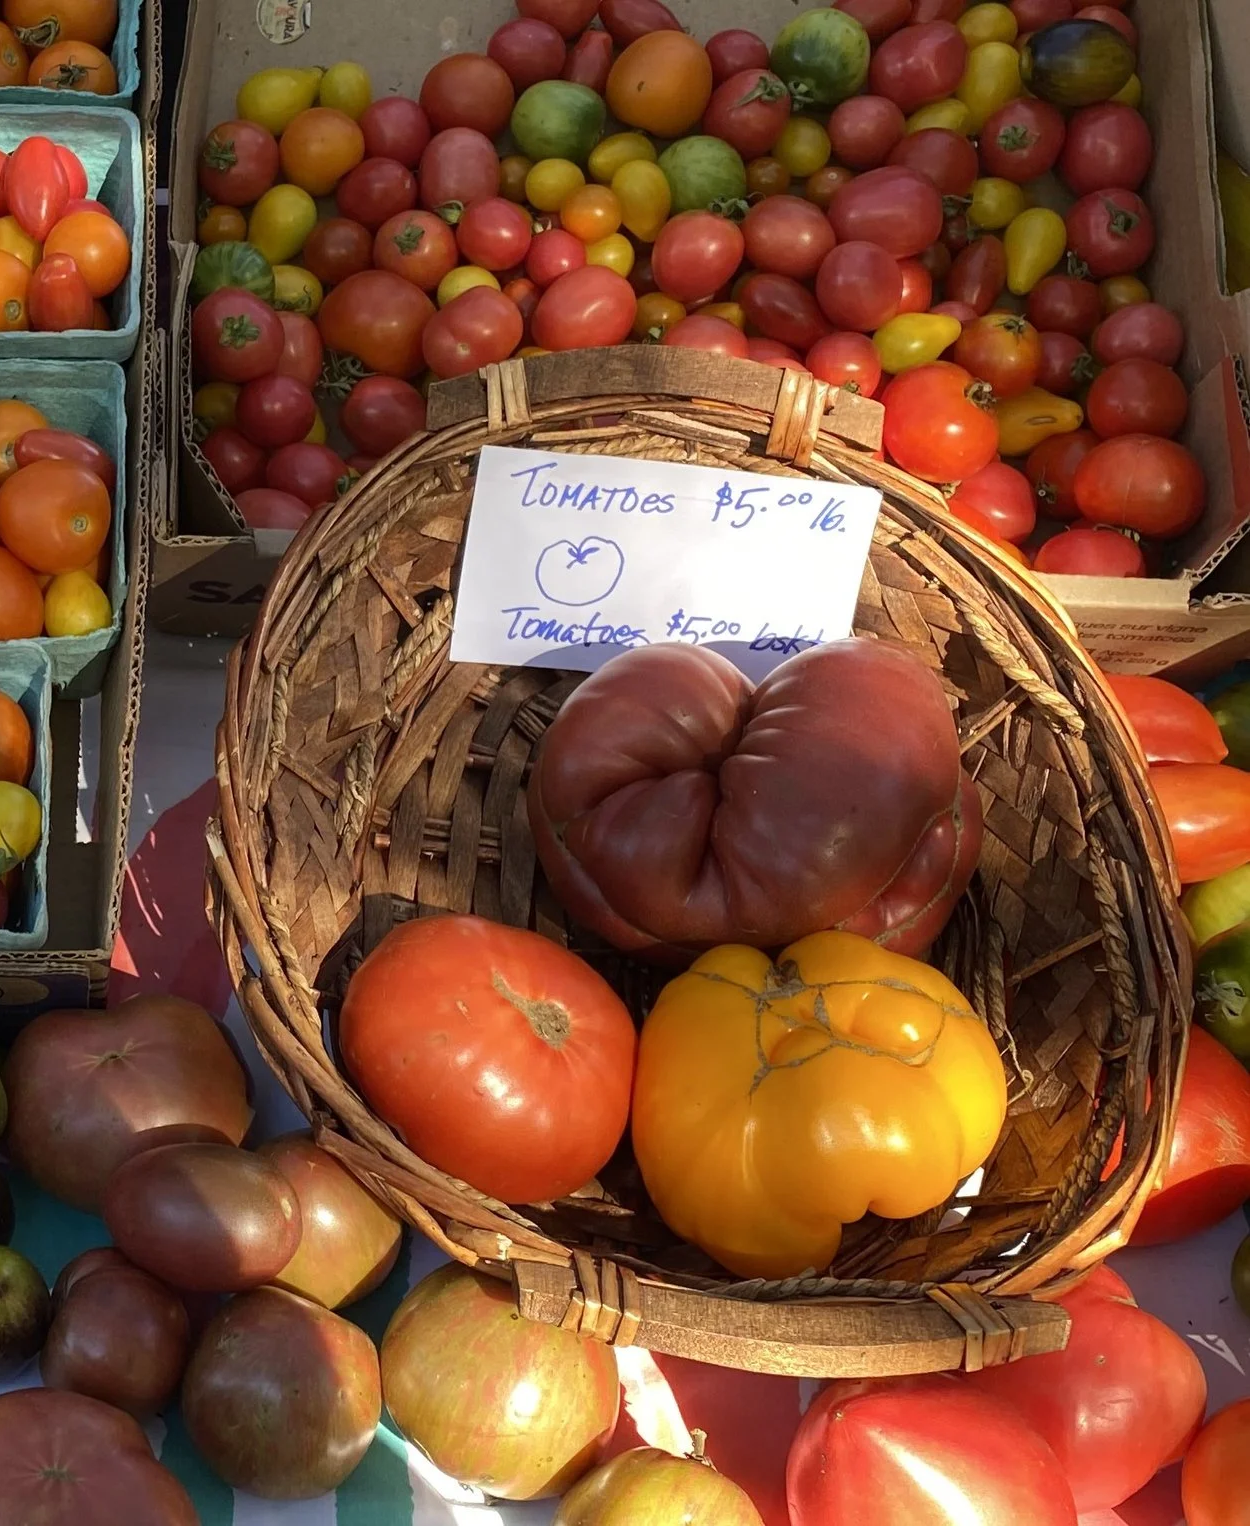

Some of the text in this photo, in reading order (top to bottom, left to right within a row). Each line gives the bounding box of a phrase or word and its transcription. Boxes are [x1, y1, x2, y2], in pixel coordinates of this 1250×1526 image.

[710, 480, 813, 529] $5.00
[809, 495, 848, 533] lb.
[501, 605, 650, 650] Tomatoes
[665, 607, 743, 644] $5.00
[1106, 633, 1196, 643] tomatoes
